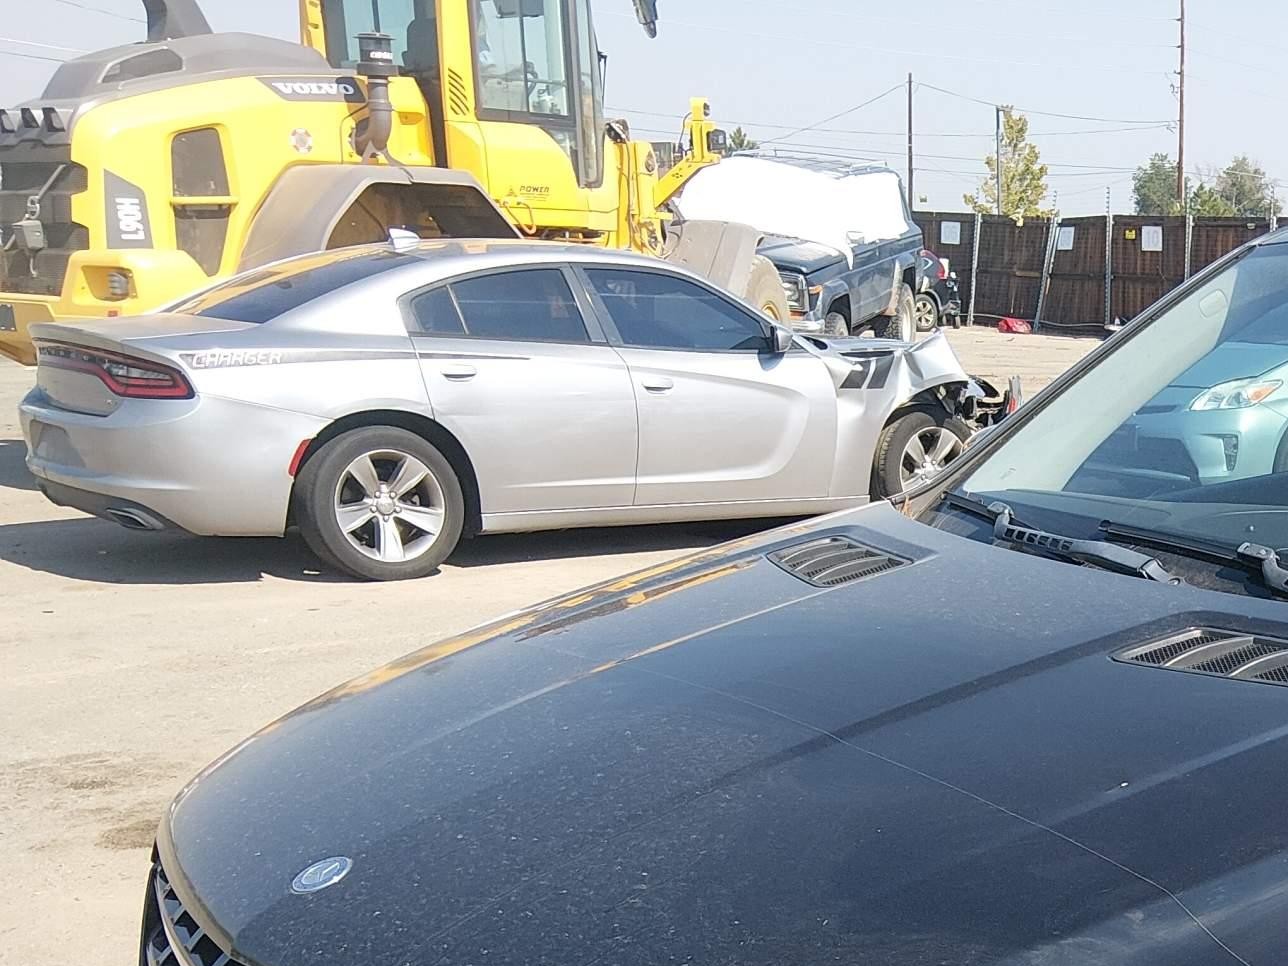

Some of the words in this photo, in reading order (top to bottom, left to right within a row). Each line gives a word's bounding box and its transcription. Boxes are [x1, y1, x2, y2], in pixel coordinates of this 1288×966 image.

[271, 82, 355, 95] VOLVO
[114, 197, 146, 240] L90H
[192, 351, 283, 369] CHARGER
